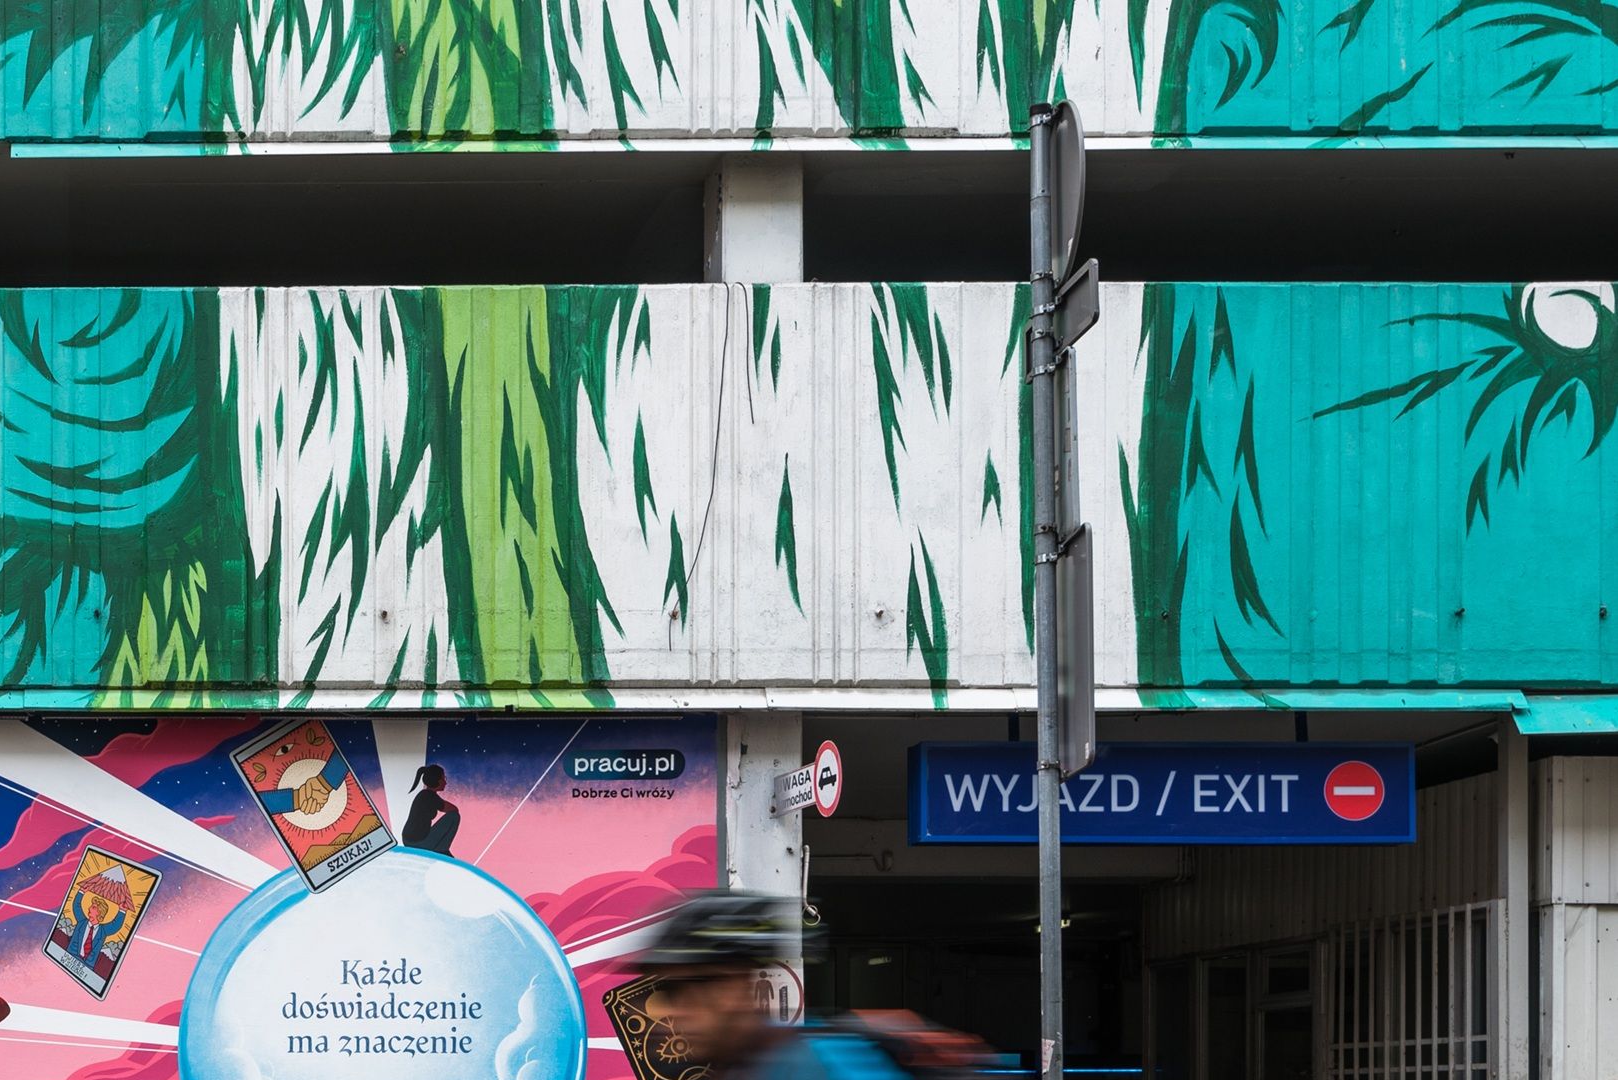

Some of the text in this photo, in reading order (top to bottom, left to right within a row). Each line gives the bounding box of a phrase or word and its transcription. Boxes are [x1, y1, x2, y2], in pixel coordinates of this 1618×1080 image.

[574, 753, 675, 776] pracuj.pl
[572, 787, 675, 799] Dobrze Ci wróży
[1193, 774, 1299, 813] EXIT
[327, 838, 374, 873] SZUKAJ!
[339, 957, 423, 989] Każde
[282, 991, 483, 1024] doświadczenie
[287, 1026, 473, 1058] ma znaczenie
